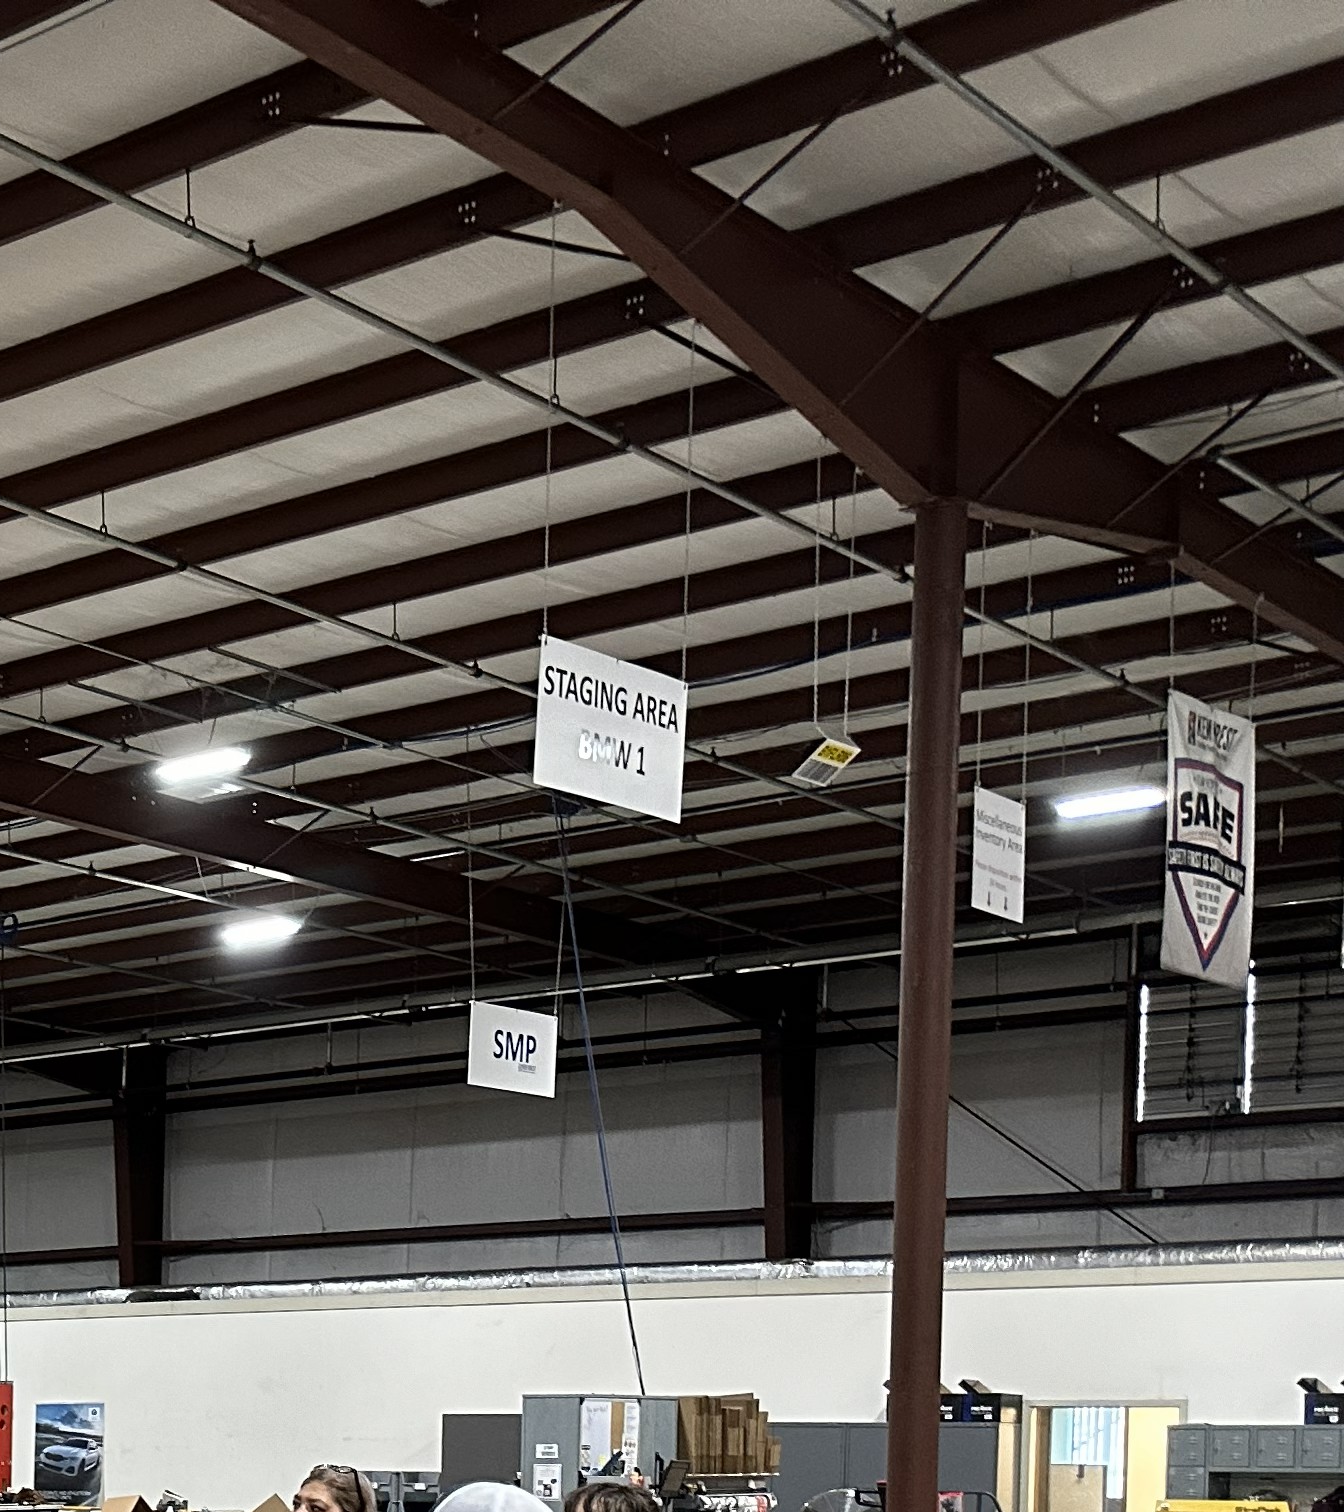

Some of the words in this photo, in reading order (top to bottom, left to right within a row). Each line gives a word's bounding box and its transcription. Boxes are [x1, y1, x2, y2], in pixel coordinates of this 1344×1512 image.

[544, 666, 627, 715] STAGING
[632, 693, 678, 733] AREA
[578, 729, 631, 769] BMW
[637, 747, 645, 775] 1
[1180, 791, 1235, 844] SAFE
[493, 1029, 537, 1063] SMP
